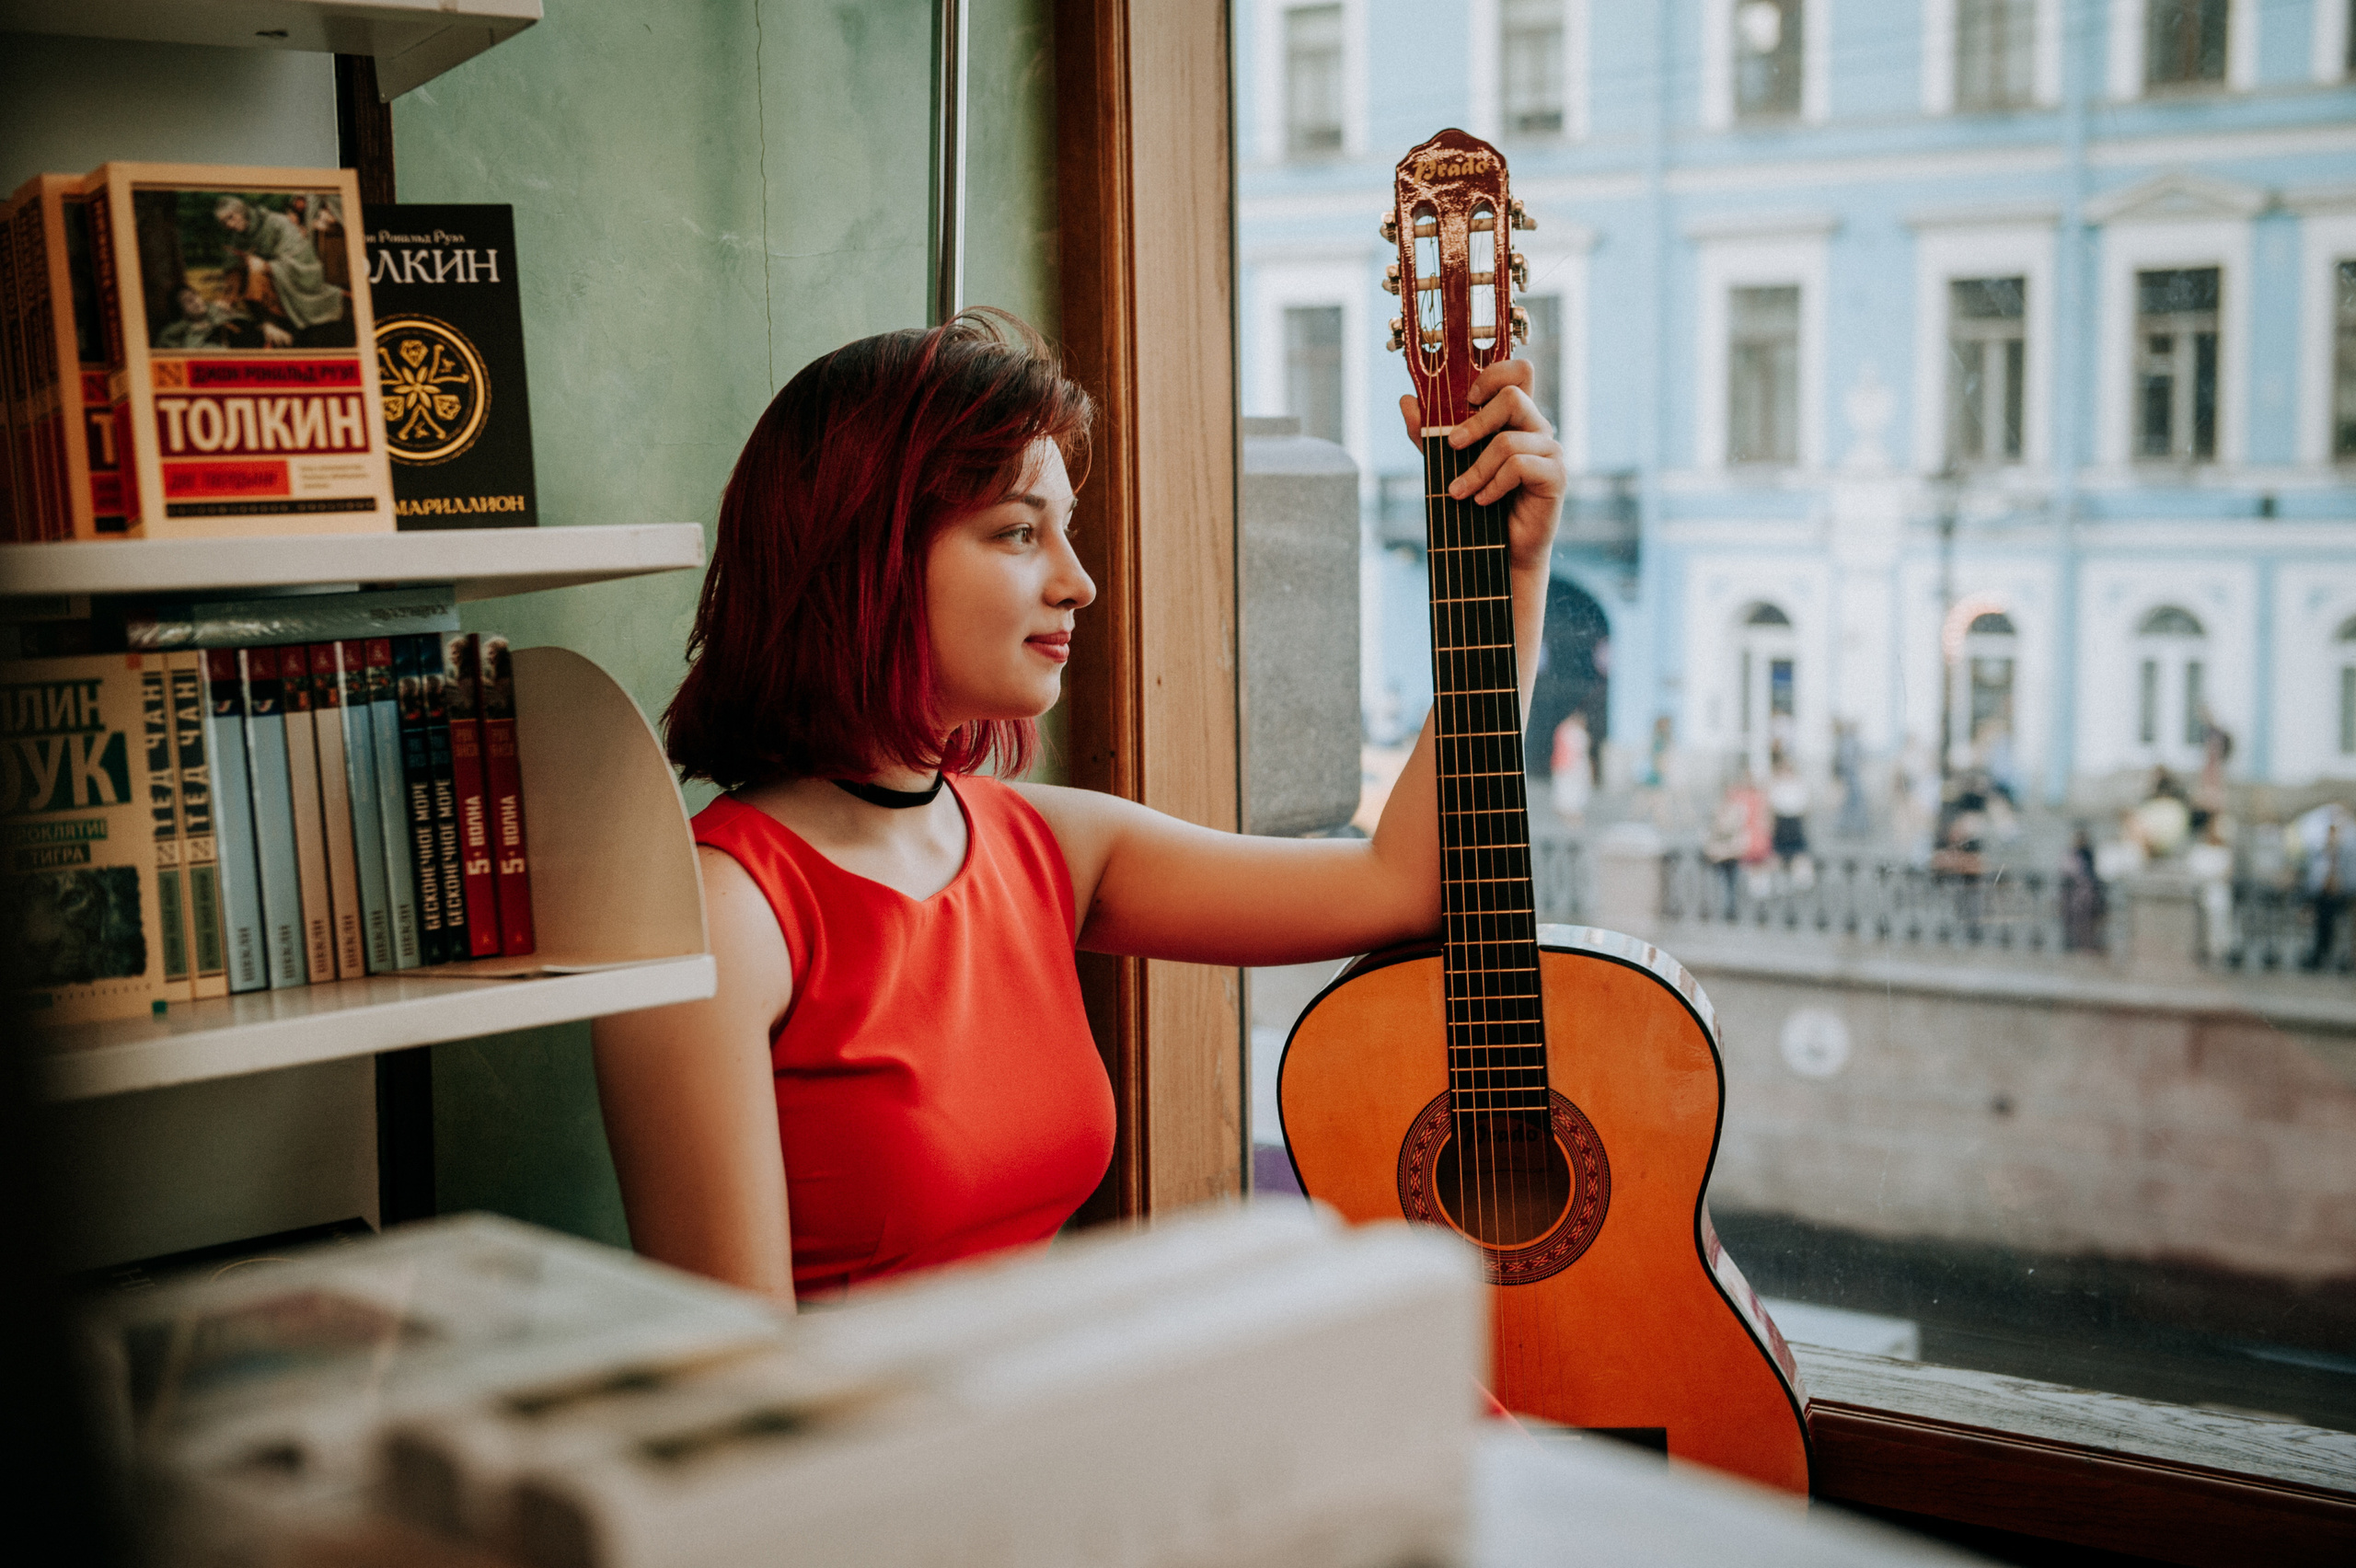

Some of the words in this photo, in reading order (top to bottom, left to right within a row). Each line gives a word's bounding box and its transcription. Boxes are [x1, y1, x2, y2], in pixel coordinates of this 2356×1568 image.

[1412, 156, 1489, 185] Prado
[366, 248, 501, 283] ЛКИН
[157, 396, 366, 453] ТОЛКИН
[144, 685, 167, 750] ЧАН
[175, 682, 201, 745] ЧАН
[148, 767, 176, 835] ТЕД
[183, 765, 209, 827] ТЕД
[411, 780, 431, 821] МОРЕ
[434, 778, 454, 817] МОРЕ
[465, 795, 485, 847] ВОЛНА
[500, 795, 520, 846] ВОЛНА
[417, 826, 442, 930] БЕСКОНЕЧНОЕ
[439, 822, 464, 926] БЕСКОНЕЧНОЕ
